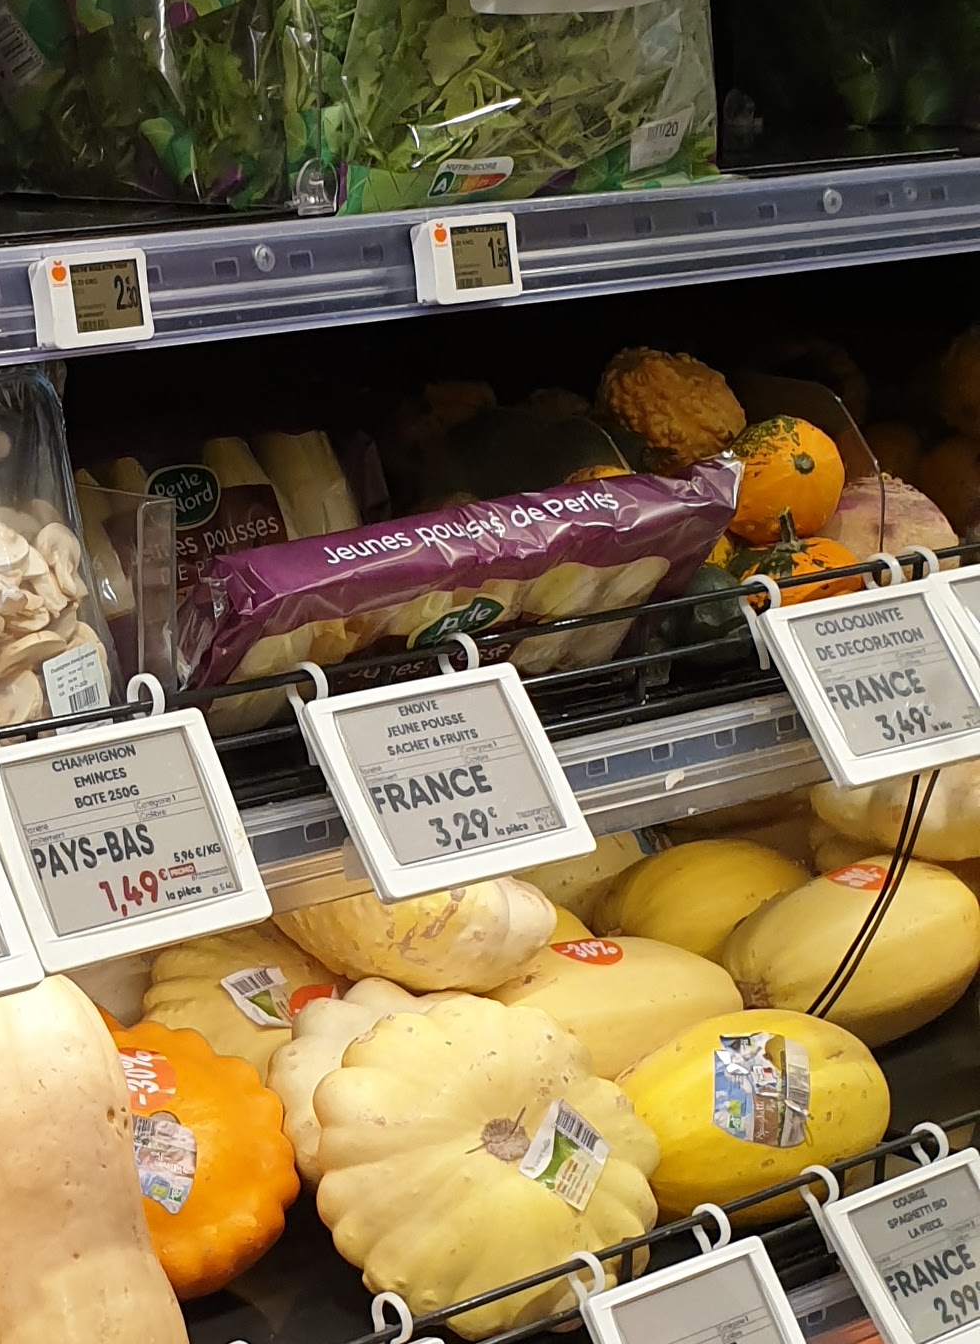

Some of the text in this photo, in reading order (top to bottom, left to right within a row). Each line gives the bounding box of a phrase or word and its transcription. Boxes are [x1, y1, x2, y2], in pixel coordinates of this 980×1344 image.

[207, 515, 280, 556] pousses
[323, 531, 414, 567] Jeunes
[511, 501, 544, 530] de
[550, 490, 620, 522] Perles
[815, 607, 905, 637] COLOQUINTE
[816, 627, 925, 663] DE DECORATION
[824, 667, 927, 711] FRANCE
[398, 699, 439, 718] ENDIVE
[386, 712, 467, 738] JEUNE POUSSE
[387, 728, 480, 756] SACHET FRUITS
[51, 743, 138, 774] CHAMPIGNON
[73, 767, 128, 789] EMINCES
[369, 764, 494, 816] FRANCE
[74, 784, 141, 810] BQTE 250G
[34, 823, 156, 882] PAYS-BAS
[177, 885, 203, 902] pièce
[892, 1188, 928, 1210] COURGE
[887, 1208, 933, 1230] SPAGHETTI
[920, 1217, 944, 1236] PIECE
[884, 1244, 977, 1303] FRANCE
